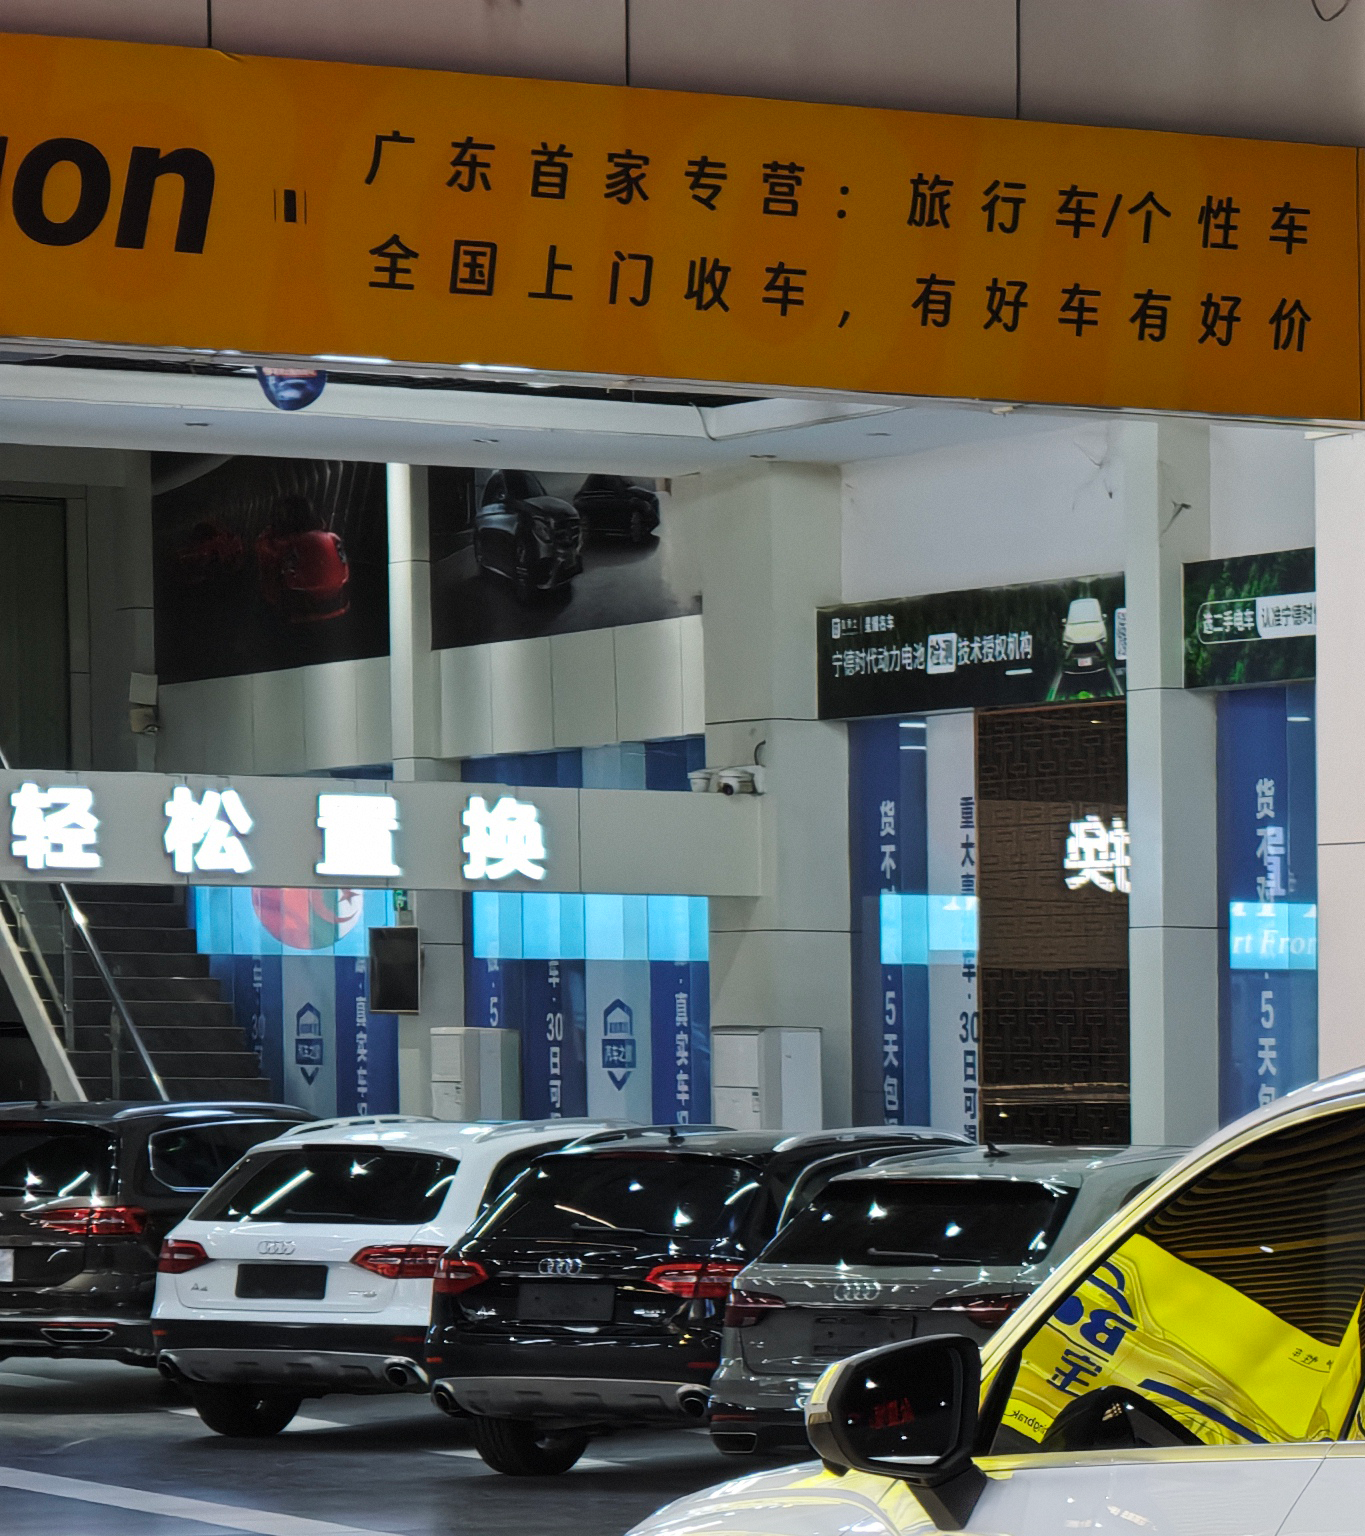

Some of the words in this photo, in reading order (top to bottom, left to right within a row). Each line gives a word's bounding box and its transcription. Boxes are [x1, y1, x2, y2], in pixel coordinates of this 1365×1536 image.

[0, 134, 216, 255] on
[10, 781, 548, 882] 轻松置换
